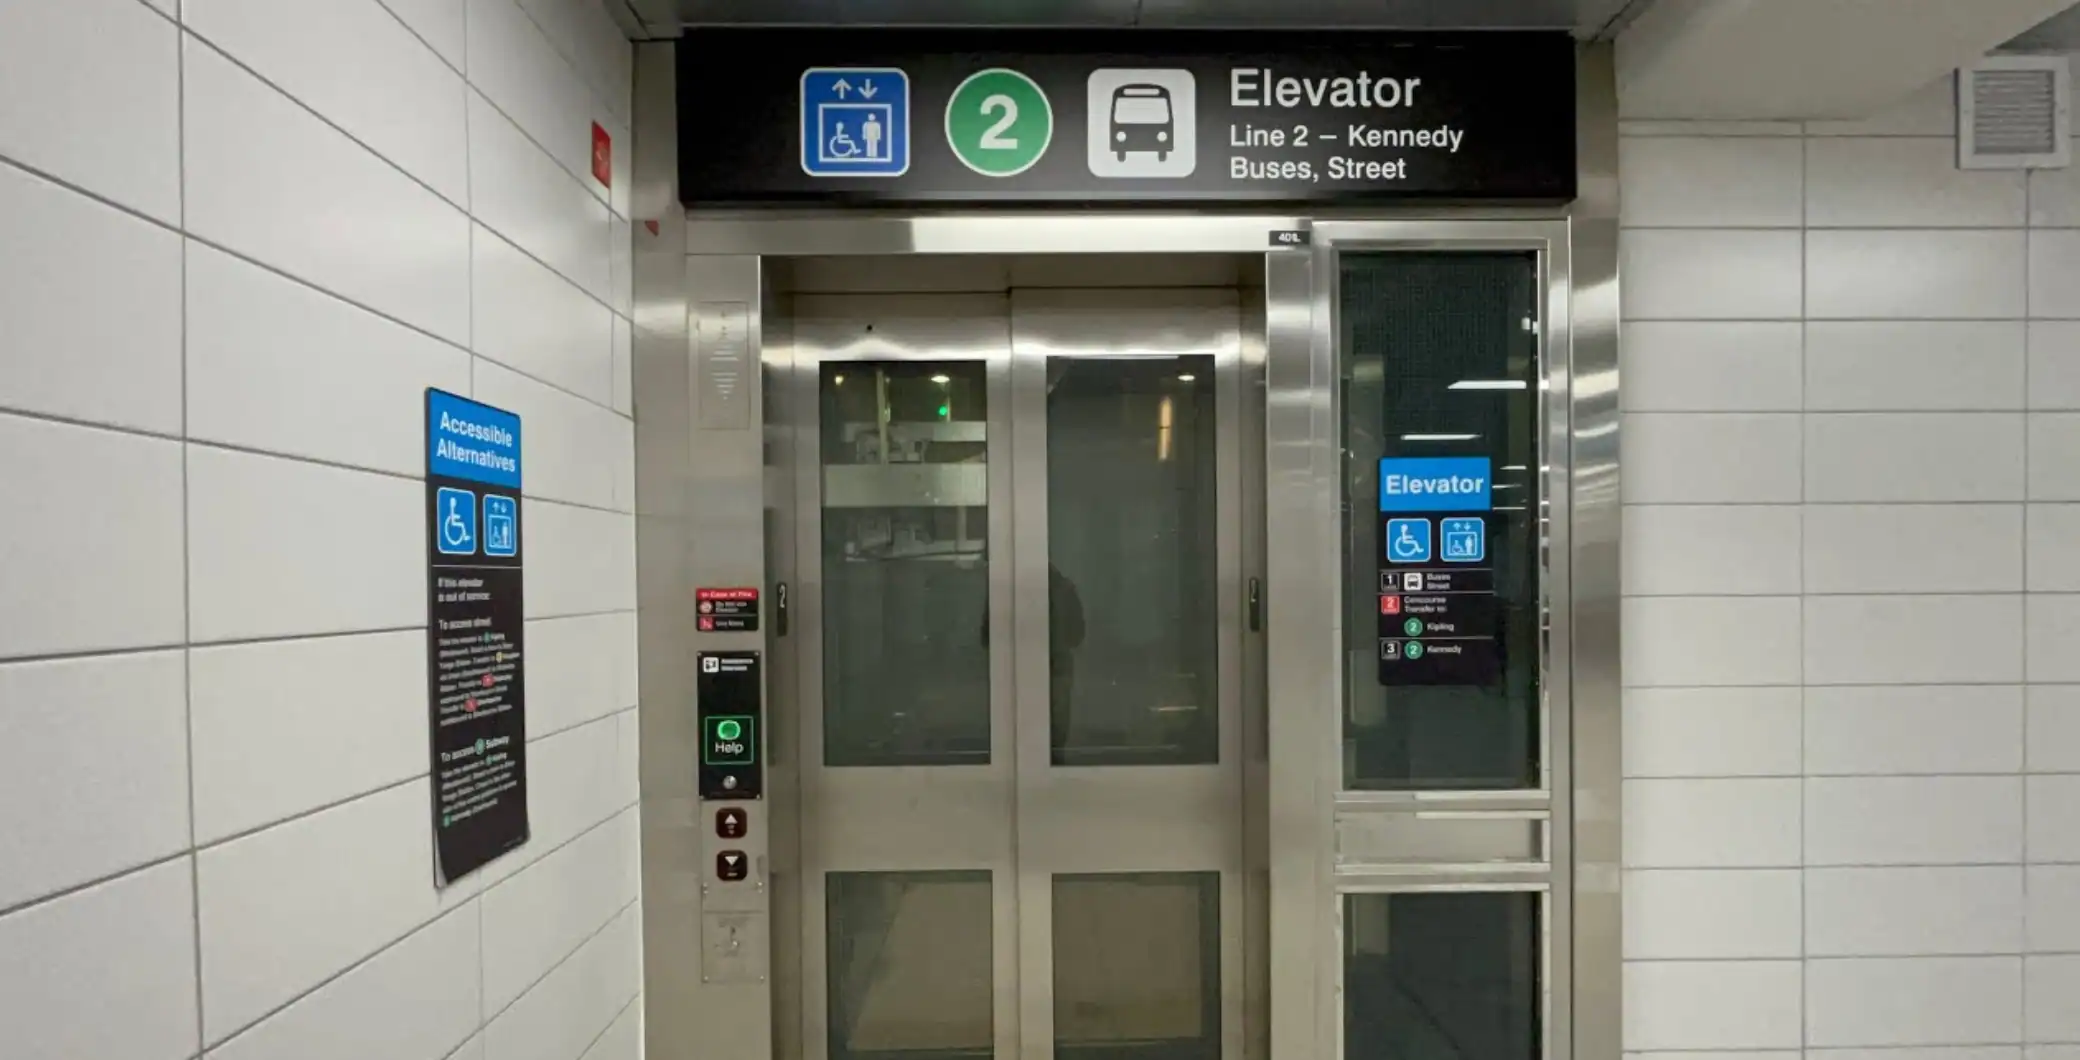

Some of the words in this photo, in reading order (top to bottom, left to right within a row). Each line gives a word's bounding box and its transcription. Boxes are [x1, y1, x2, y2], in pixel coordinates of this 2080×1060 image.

[1231, 68, 1421, 108] Elevator
[980, 94, 1018, 149] 2
[1231, 124, 1286, 147] Line
[1293, 124, 1309, 147] 2
[1349, 124, 1464, 153] Kennedy
[1231, 156, 1319, 183] Buses,
[1328, 156, 1407, 179] Street
[440, 411, 512, 448] Accessible
[436, 437, 516, 472] Alternatives
[1385, 474, 1485, 495] Elevator
[1387, 574, 1393, 585] 1
[779, 584, 786, 608] 2
[1387, 597, 1394, 608] 2
[1409, 622, 1417, 633] 2
[1387, 643, 1395, 653] 3
[1409, 645, 1417, 656] 2
[715, 742, 744, 756] Help
